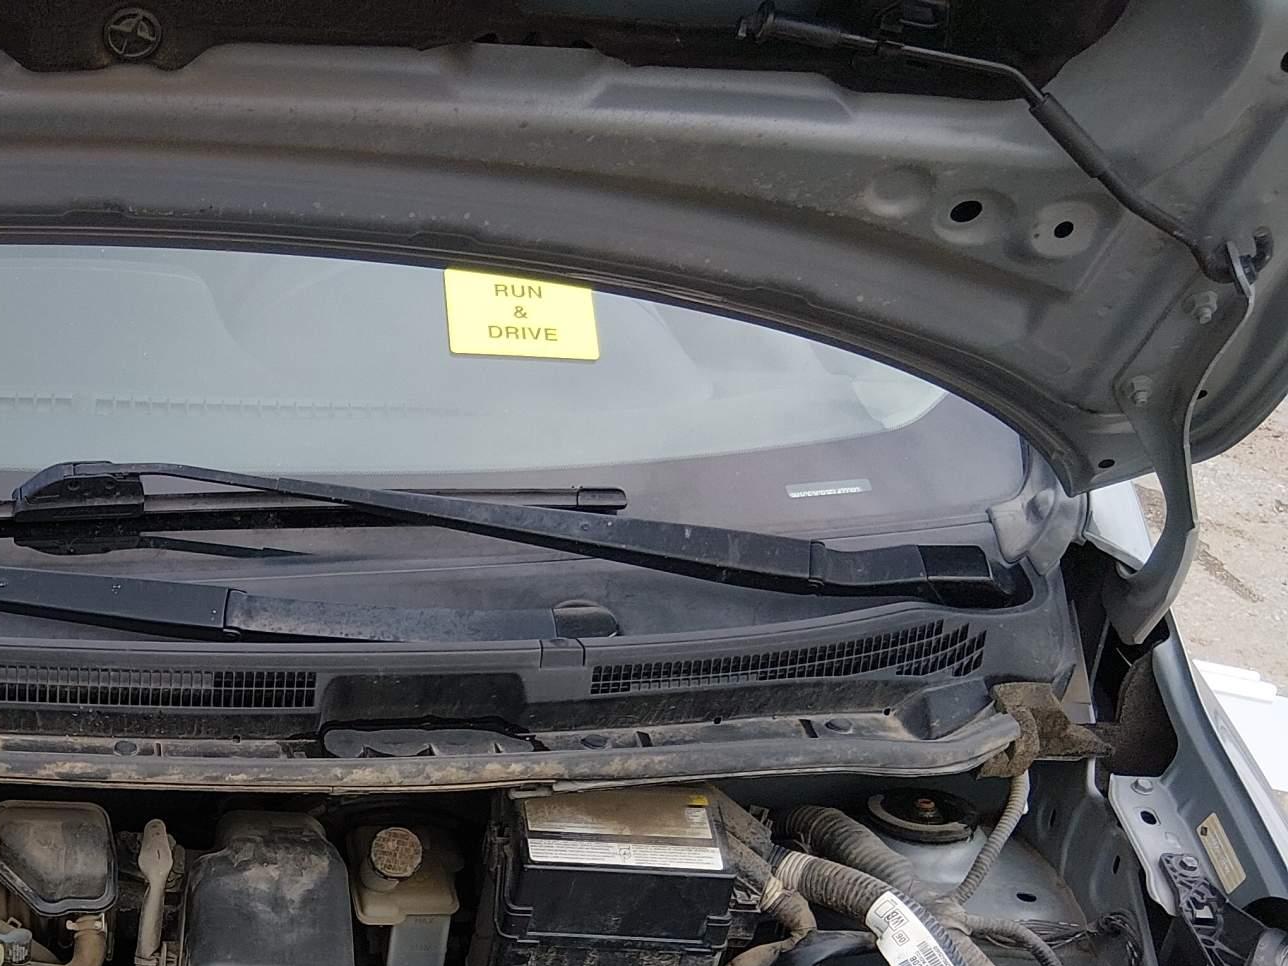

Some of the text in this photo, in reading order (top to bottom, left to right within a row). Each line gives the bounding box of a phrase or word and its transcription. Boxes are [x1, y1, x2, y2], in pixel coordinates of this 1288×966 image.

[494, 284, 543, 298] RUN
[513, 306, 528, 319] &
[488, 325, 559, 342] DRIVE
